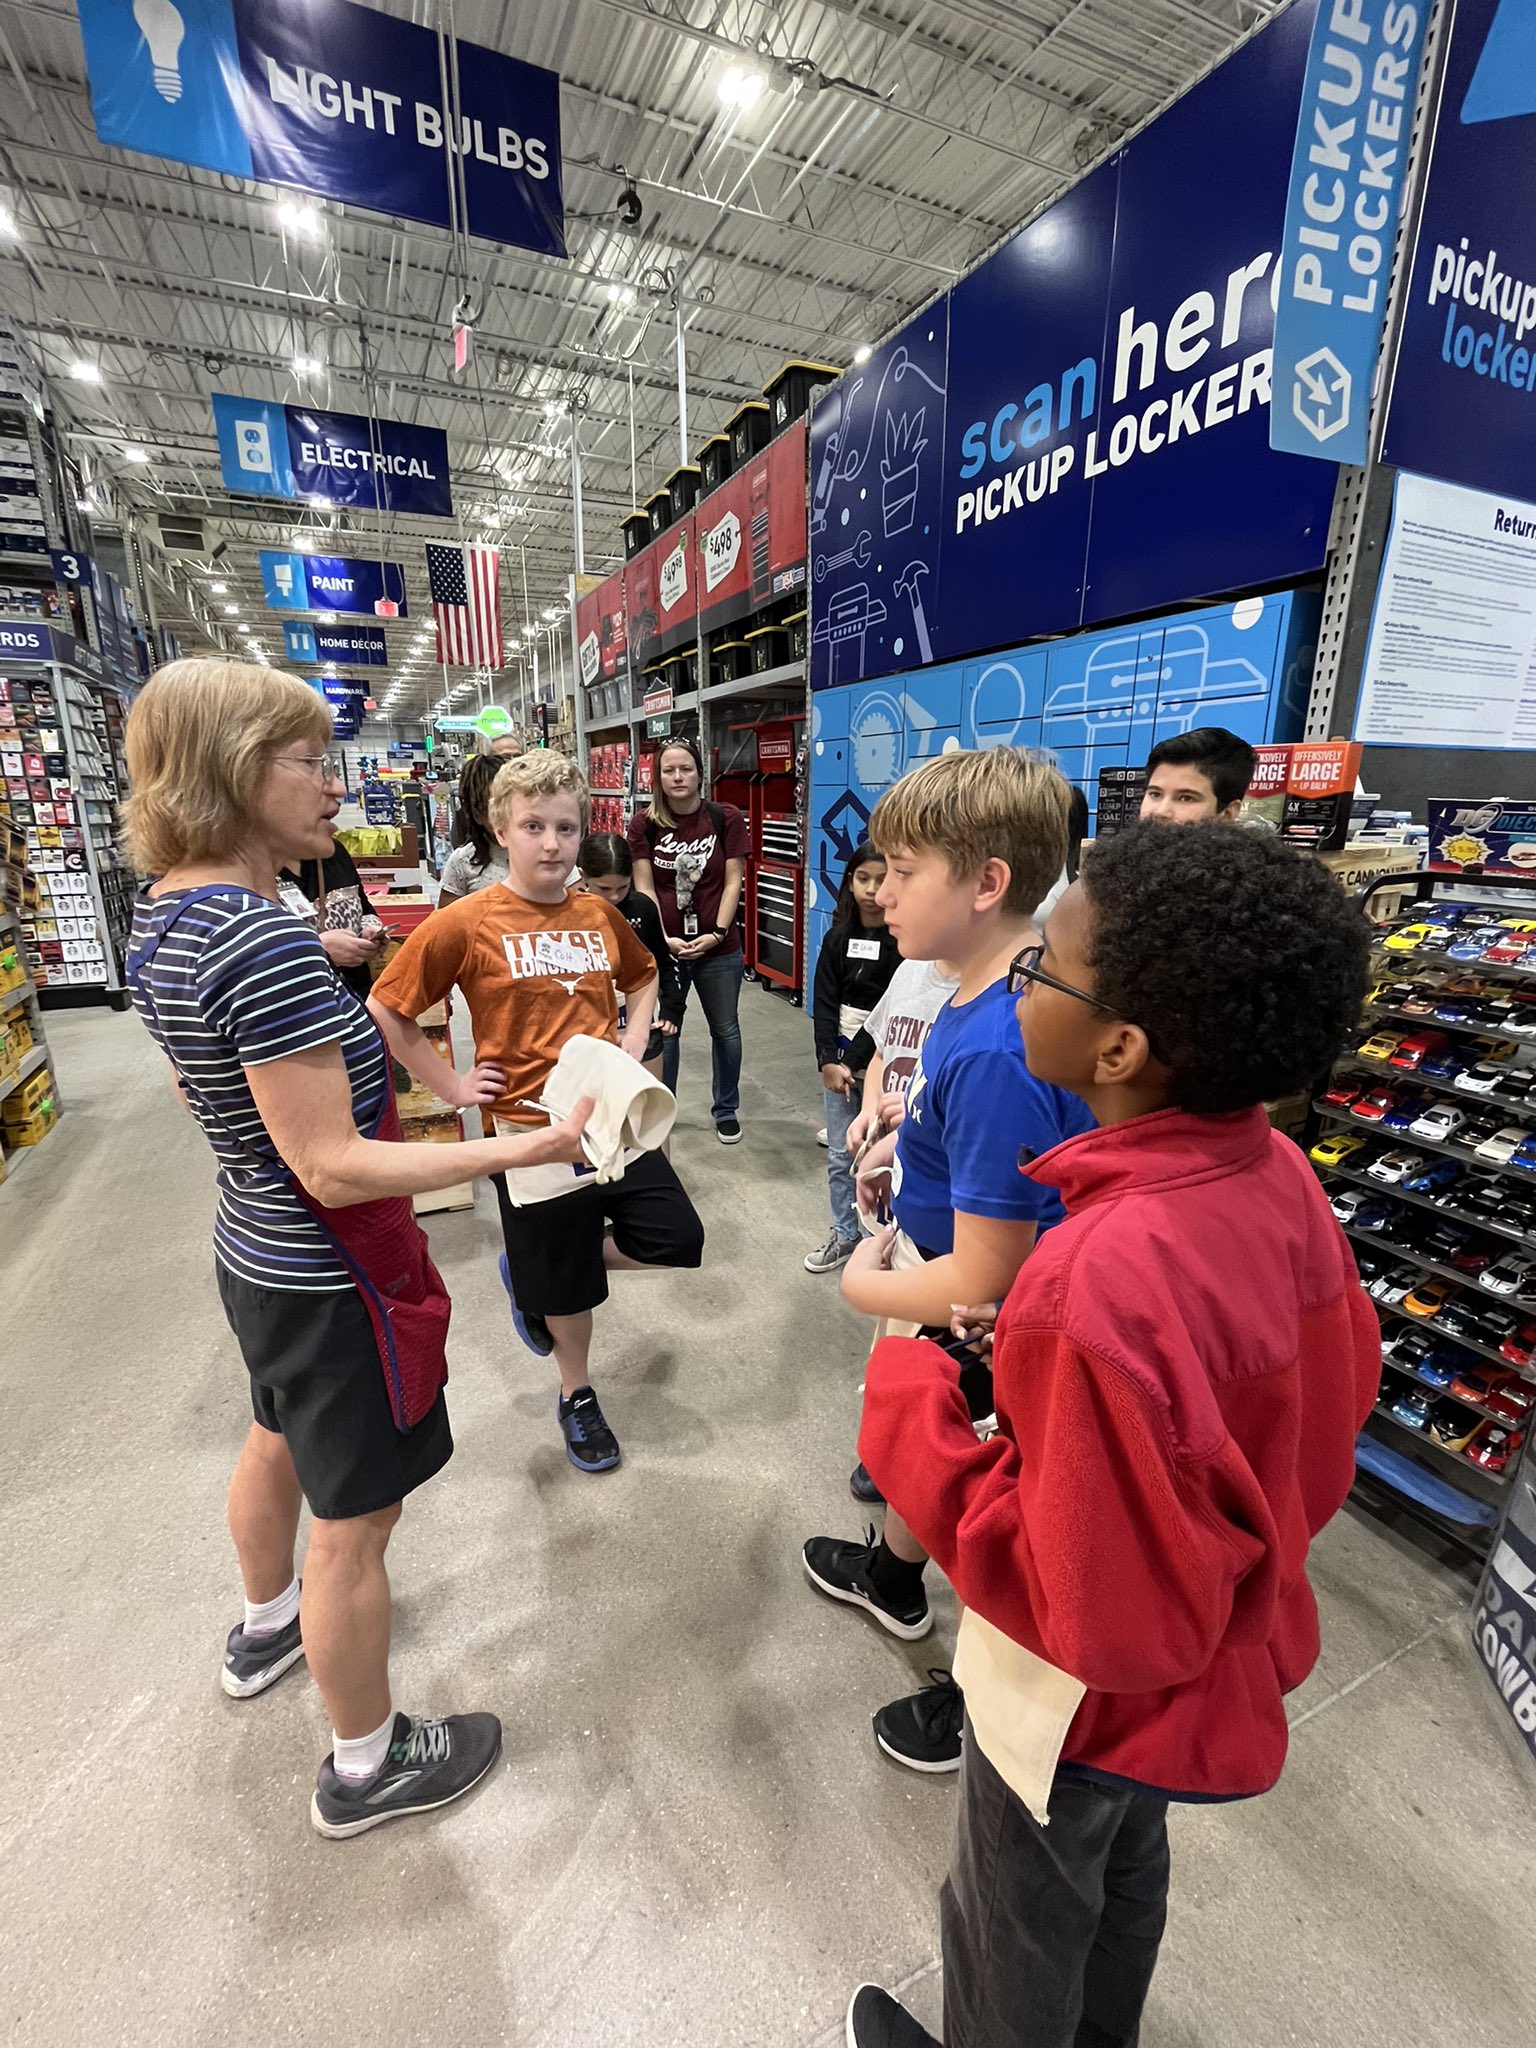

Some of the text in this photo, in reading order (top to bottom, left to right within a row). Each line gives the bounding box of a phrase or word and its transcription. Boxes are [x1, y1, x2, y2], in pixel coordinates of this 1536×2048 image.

[267, 57, 549, 180] LIGHT BULBS
[1294, 0, 1371, 305] PICKUP
[1343, 0, 1417, 314] LOCKERS
[1428, 237, 1536, 341] pickup
[959, 252, 1283, 480] scan her
[955, 348, 1273, 536] PICKUP LOCKER
[301, 441, 437, 481] ELECTRICAL
[1494, 508, 1536, 540] Return
[709, 527, 732, 558] $498
[61, 555, 80, 579] 3
[312, 575, 355, 592] PAINT
[0, 632, 40, 648] RDS
[319, 637, 349, 649] HOME
[1258, 752, 1287, 763] NSIVELY
[1294, 750, 1343, 762] OFFENSIVELY
[1252, 763, 1287, 782] ARGE
[1291, 762, 1342, 781] LARGE
[1498, 815, 1536, 831] DIEC
[654, 832, 717, 860] Legacy
[509, 953, 612, 979] LONRNS
[885, 1015, 925, 1050] STIN
[1473, 1606, 1536, 1732] COWB
